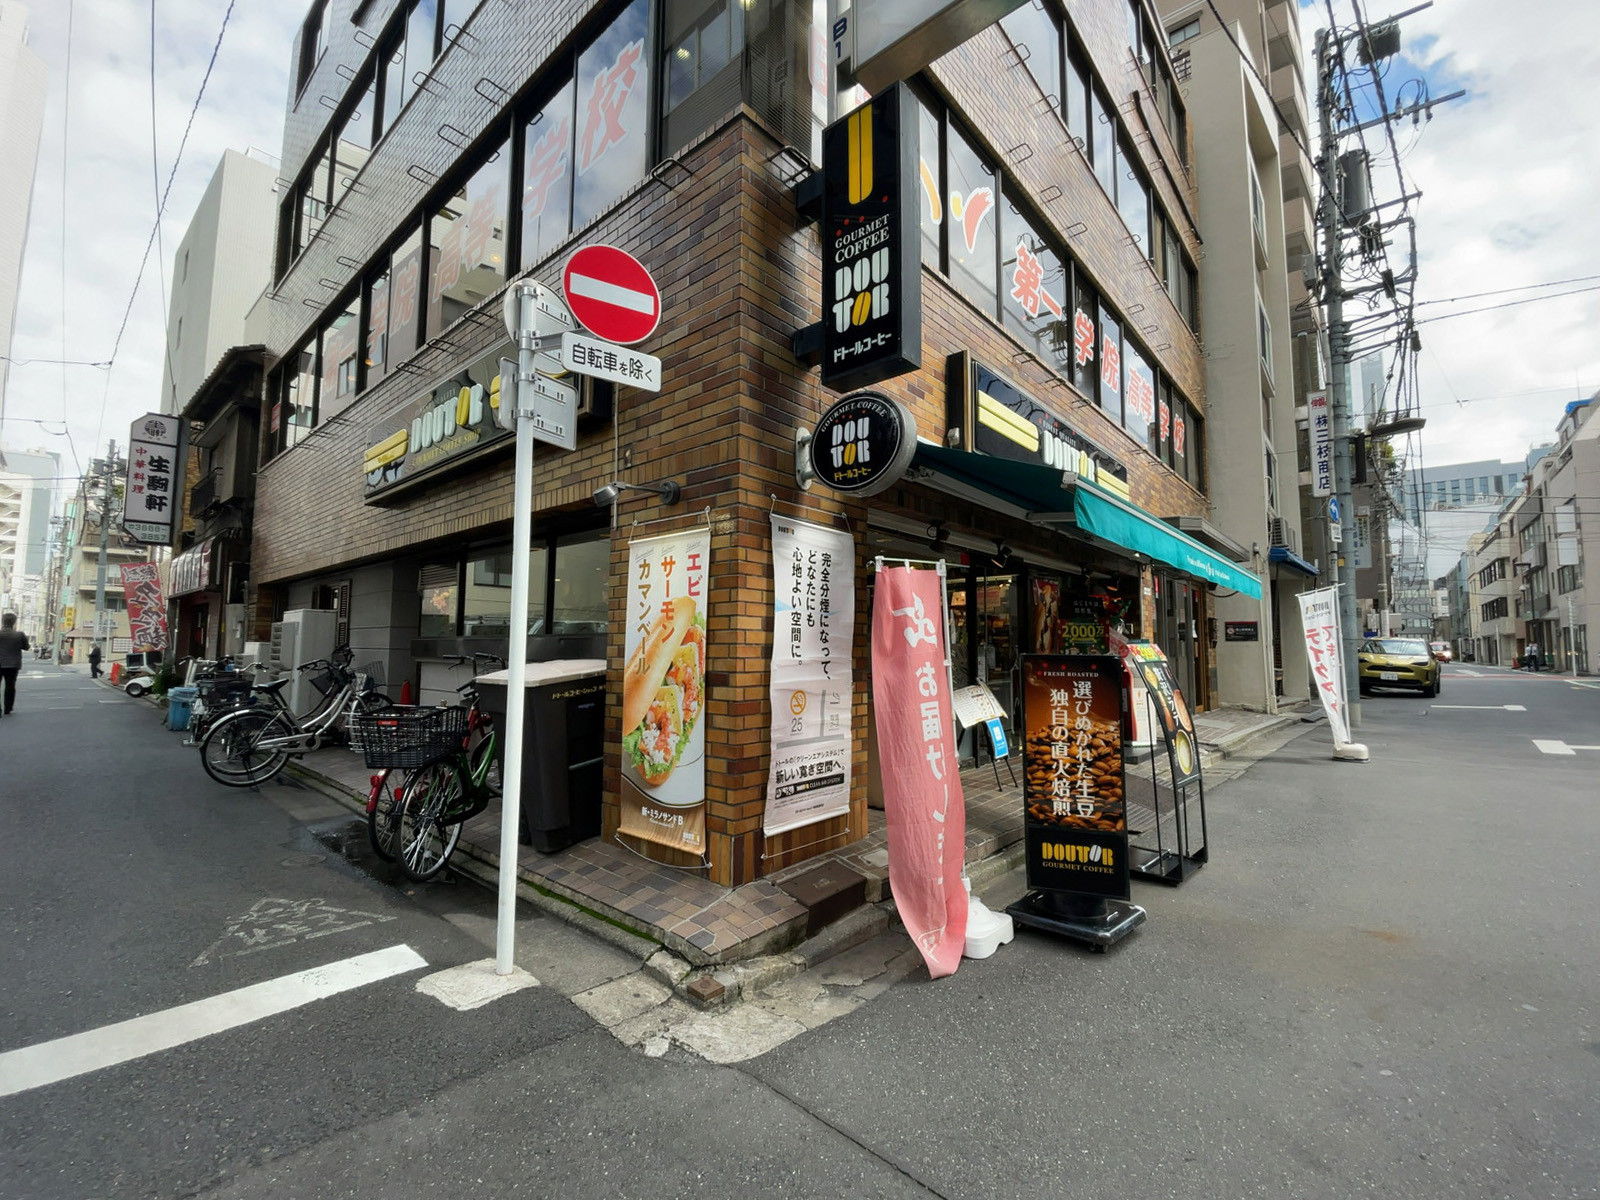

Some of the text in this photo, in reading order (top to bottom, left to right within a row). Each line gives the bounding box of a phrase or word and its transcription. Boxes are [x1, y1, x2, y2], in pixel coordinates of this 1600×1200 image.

[835, 214, 889, 249] GOURMET
[835, 226, 889, 263] COFFEE
[572, 343, 653, 383] 自転車を除く
[833, 333, 892, 363] ドトールコーヒー
[411, 383, 484, 454] DOUTOR
[821, 401, 888, 433] GOURMET COFFEE
[132, 447, 148, 494] 中華料理
[145, 455, 170, 512] 生駒軒
[834, 467, 872, 481] ドトールコーヒー
[686, 553, 703, 597] エビ
[806, 549, 817, 628] どなたにも
[636, 558, 651, 676] カマンベール
[660, 555, 676, 643] サーモン
[790, 546, 803, 666] 心地よい空間に。
[819, 552, 832, 681] 完全分煙になって、
[791, 717, 803, 732] 25
[1050, 688, 1071, 817] 独自の直火焙煎
[1072, 680, 1096, 819] 選びぬかれた生豆
[775, 760, 845, 784] 新しい寛ぎ空間へ。
[1042, 842, 1114, 866] DOUTOR
[1042, 861, 1114, 875] GOURMET COFFEE
